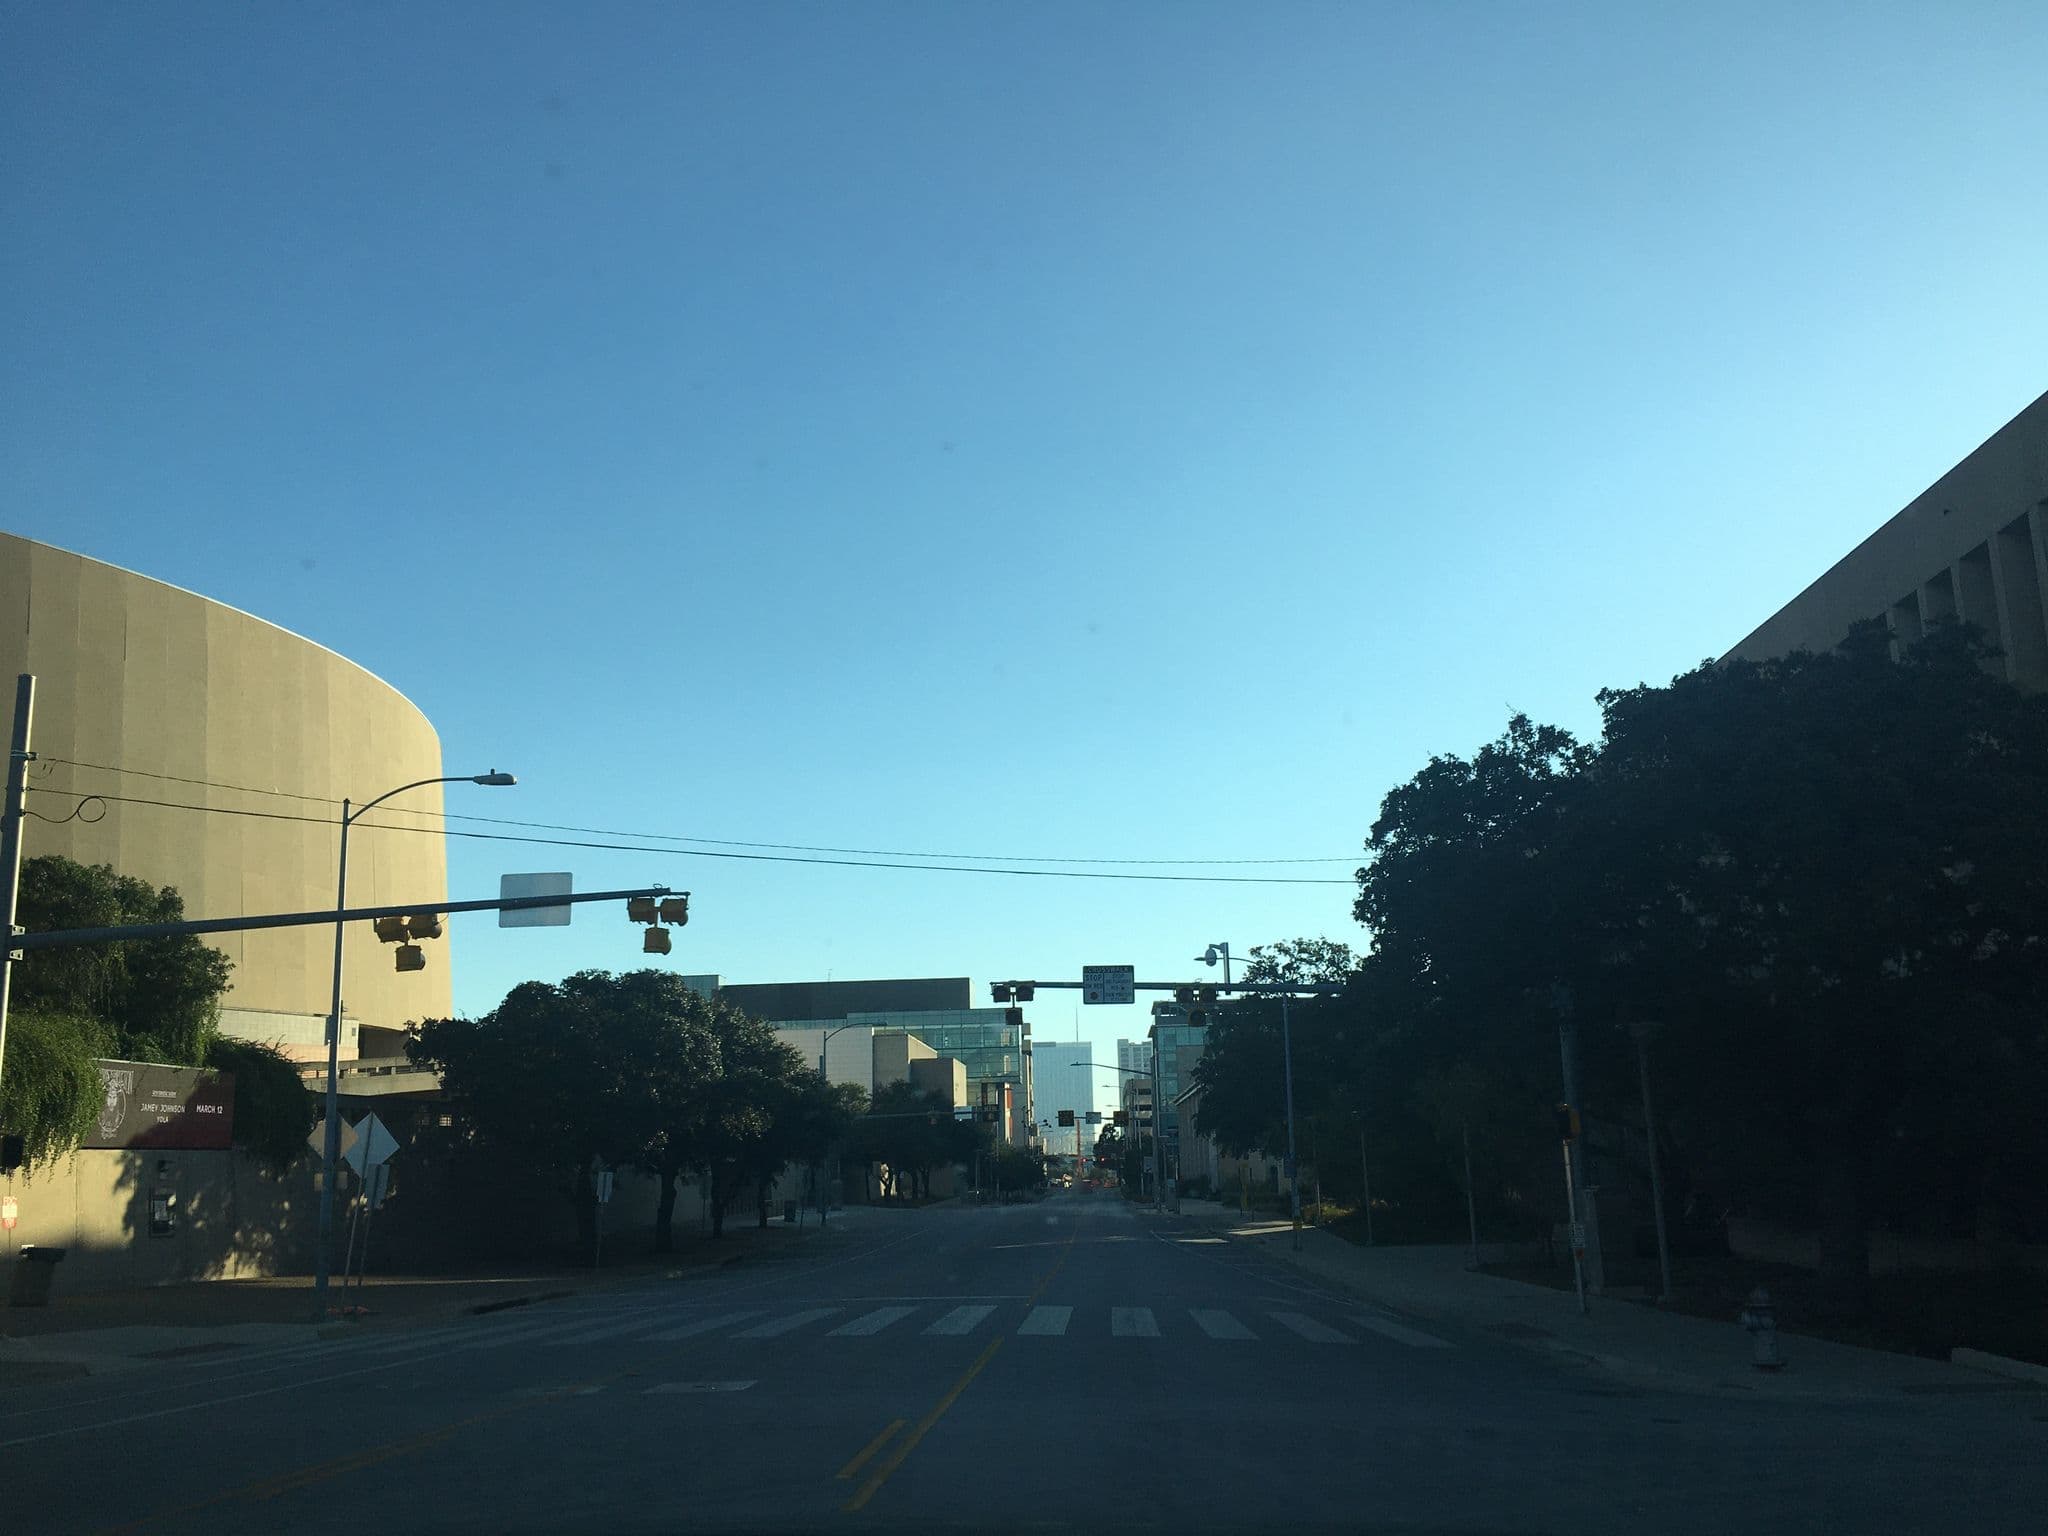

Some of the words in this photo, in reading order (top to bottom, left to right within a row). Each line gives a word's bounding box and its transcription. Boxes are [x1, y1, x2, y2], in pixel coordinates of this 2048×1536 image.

[140, 1103, 158, 1112] JAMEY
[160, 1104, 186, 1113] JOHNSON
[196, 1104, 216, 1113] MARCH
[217, 1105, 223, 1114] 12
